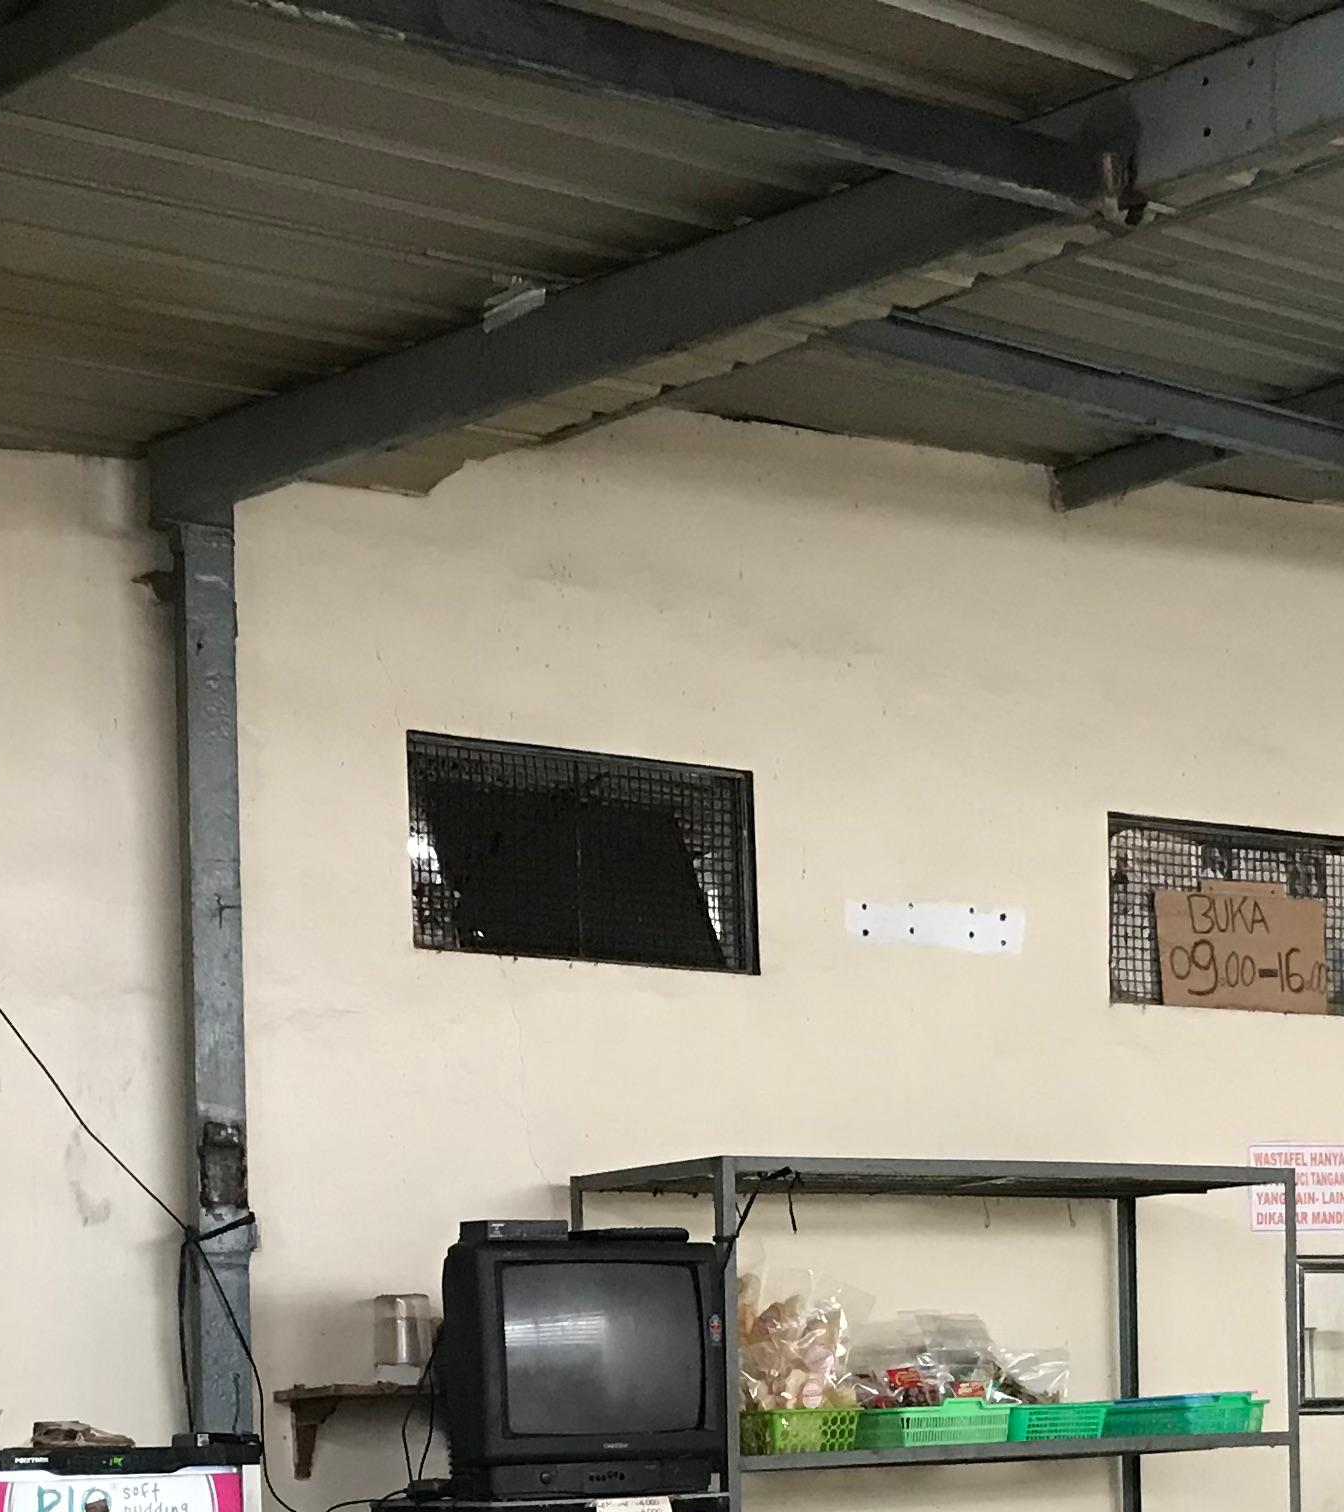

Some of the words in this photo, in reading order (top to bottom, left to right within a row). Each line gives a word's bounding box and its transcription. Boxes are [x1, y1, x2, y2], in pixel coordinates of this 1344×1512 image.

[1187, 893, 1269, 935] BUKA
[1253, 1152, 1307, 1167] WASTAFEL
[1257, 1212, 1308, 1225] DIKAAR
[122, 1482, 160, 1502] soft
